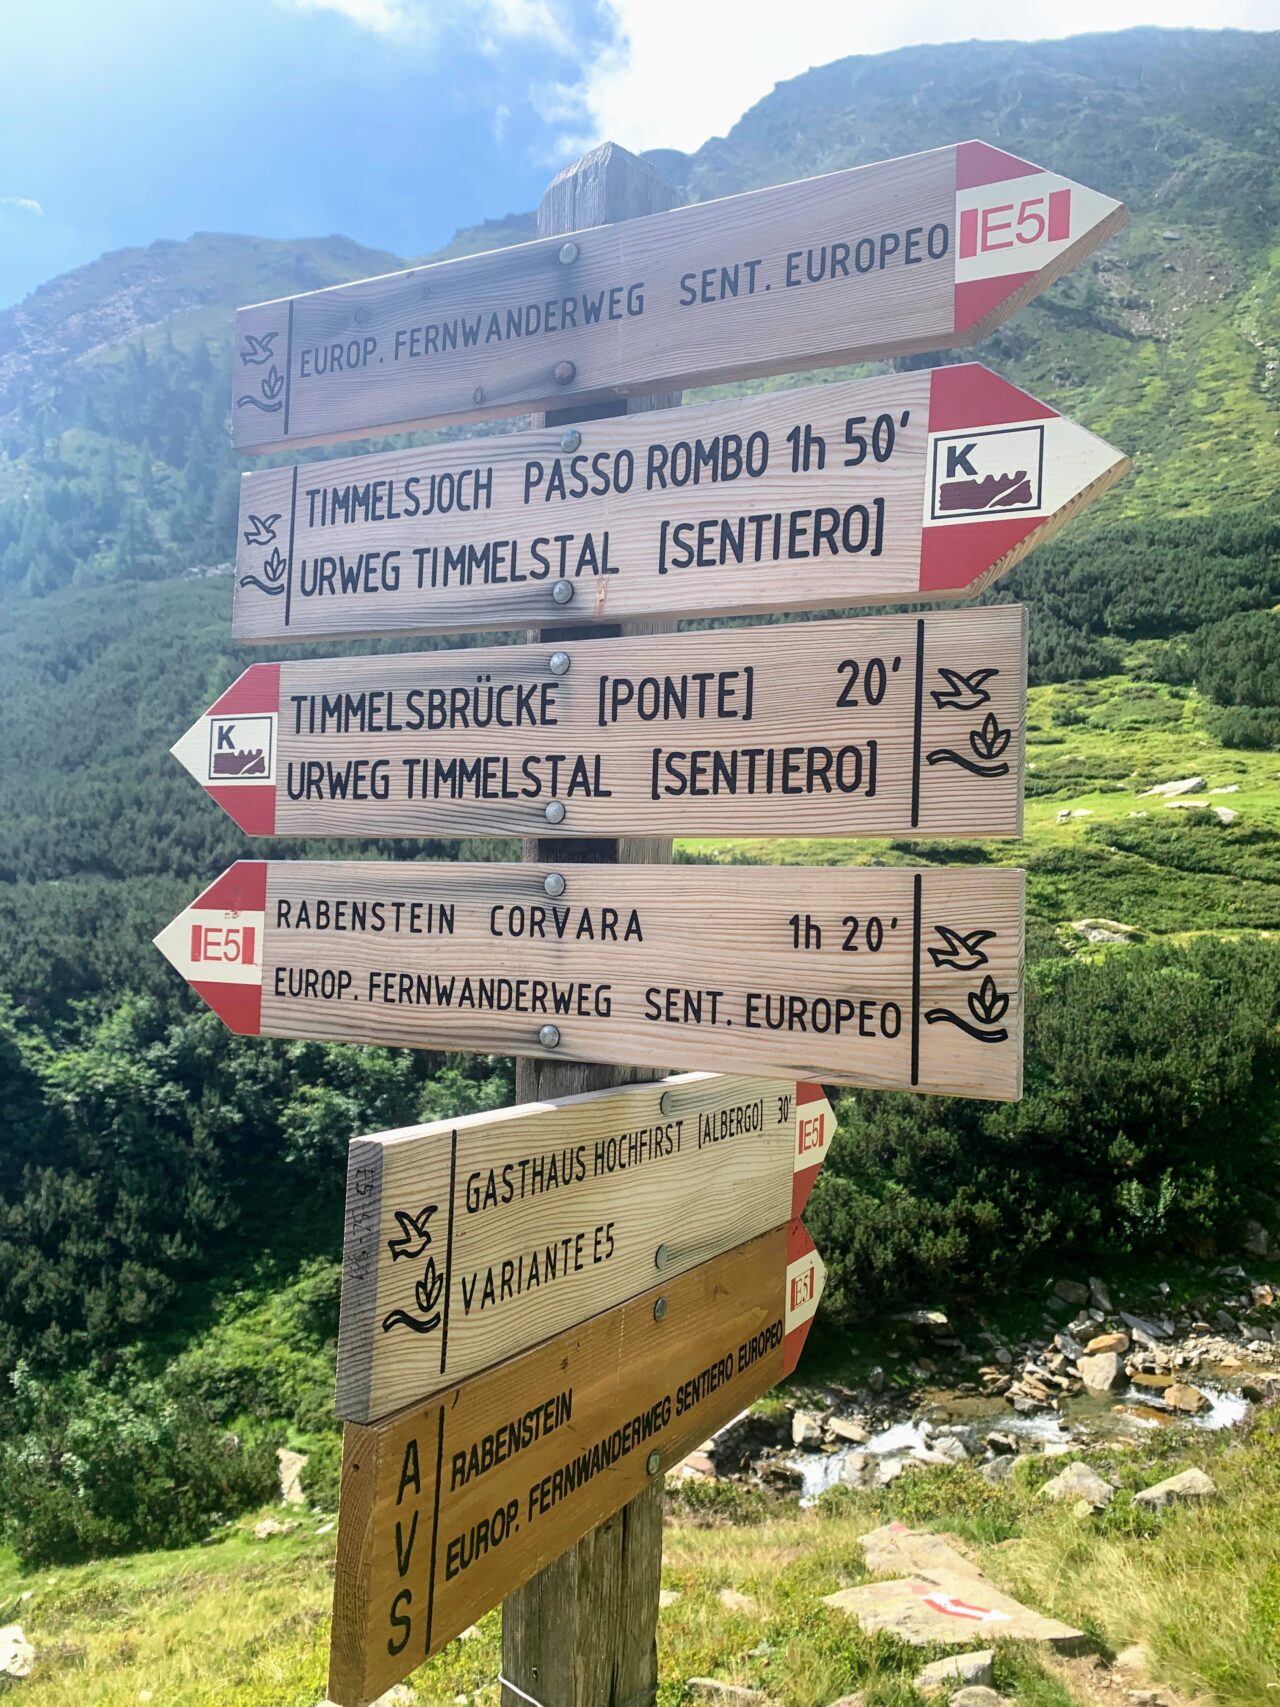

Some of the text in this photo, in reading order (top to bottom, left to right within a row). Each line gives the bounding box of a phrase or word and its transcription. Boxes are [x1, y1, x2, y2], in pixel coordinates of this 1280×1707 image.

[981, 198, 1046, 252] E5
[300, 223, 950, 377] EUROP. FERNWANDERWEG SENT. EUROPEO
[305, 467, 493, 527] TIMMELSJOCH
[524, 449, 634, 504] PASSO
[647, 430, 769, 491] ROMBO
[787, 424, 825, 474] 1h
[946, 443, 978, 478] K
[301, 550, 400, 597] URWEG
[412, 531, 619, 589] TIMMELSTAL
[290, 675, 559, 734] TIMMELSBRÜCKE
[217, 725, 235, 750] K
[287, 759, 390, 800] URWEG
[402, 754, 612, 799] TIMMELSTAL
[204, 928, 241, 961] E5
[277, 899, 455, 935] RABENSTEIN
[490, 905, 644, 942] CORVARA
[789, 914, 821, 950] 1h
[274, 967, 901, 1039] EUROP. FERNWANDERWEG SENT. EUROPEO
[803, 1118, 819, 1150] E5
[466, 1145, 586, 1214] GASTHAUS
[594, 1120, 683, 1177] HOCHFIRST
[461, 1222, 615, 1316] VARIANTE E5
[795, 1274, 809, 1306] E5
[445, 1319, 783, 1581] EUROP. FERNWANDERWEG SENTIERO EUROPEO
[450, 1387, 573, 1492] RABENSTEIN
